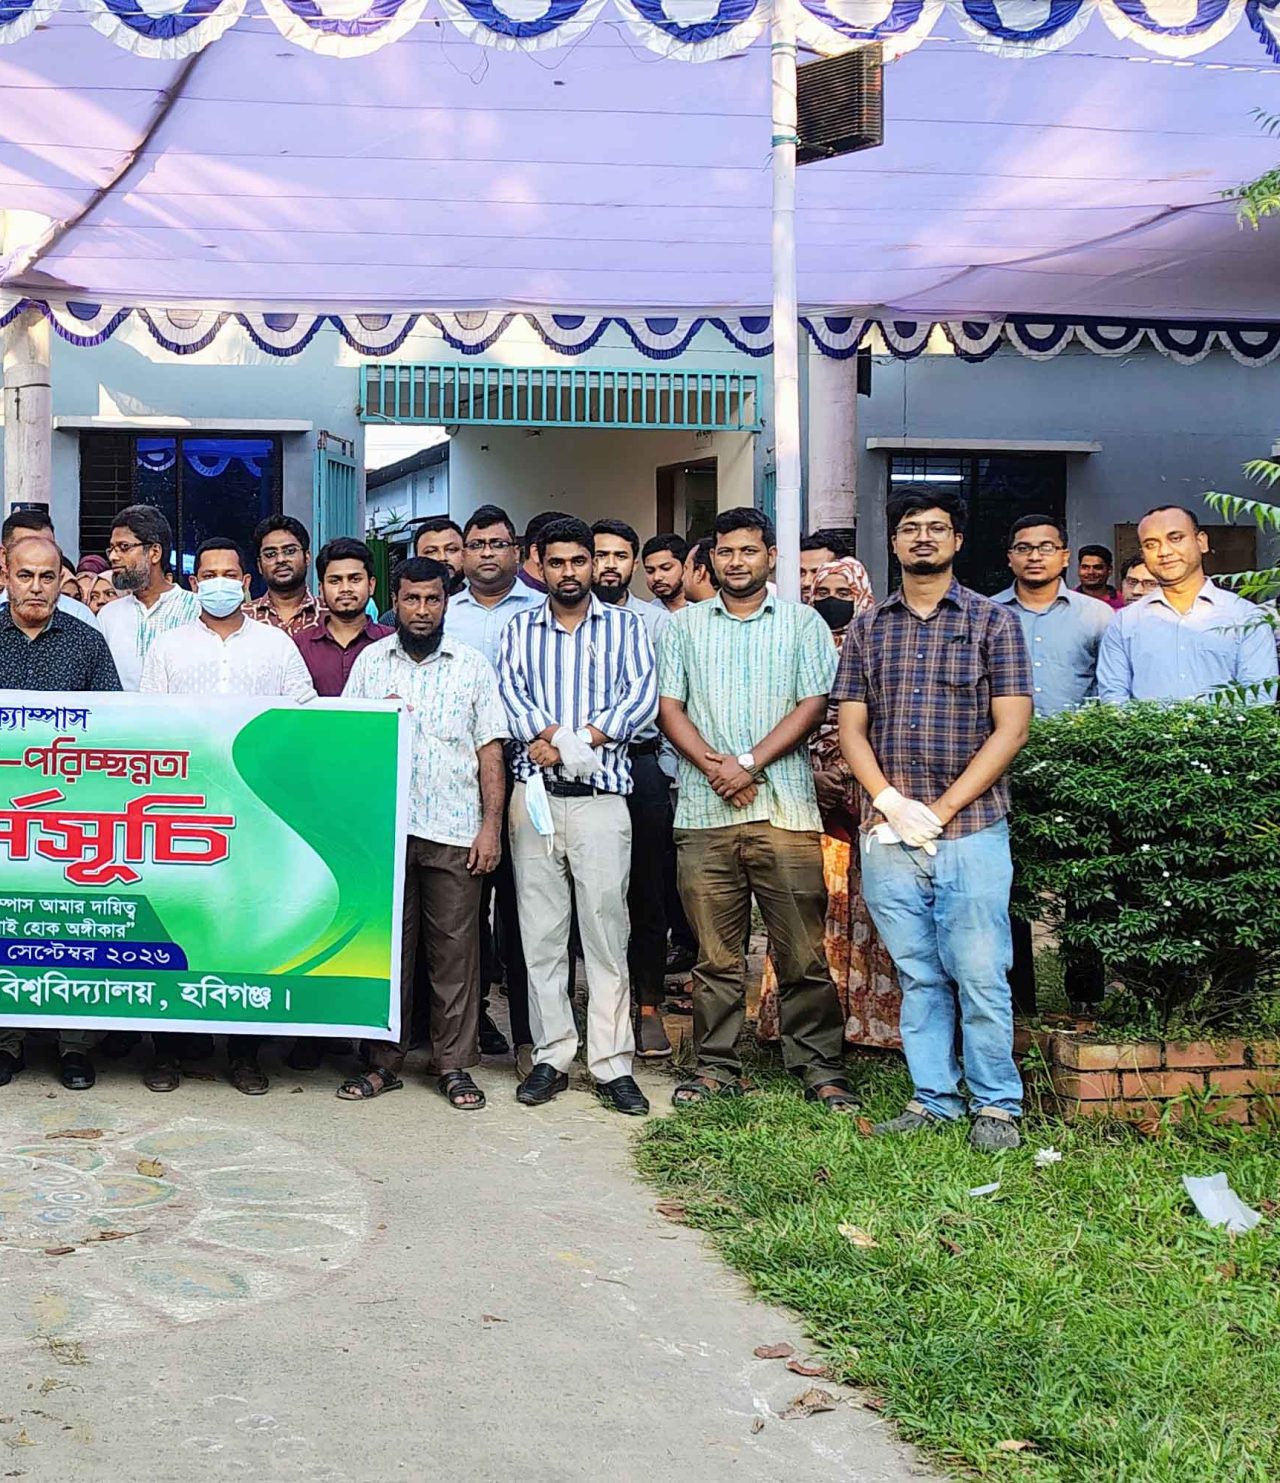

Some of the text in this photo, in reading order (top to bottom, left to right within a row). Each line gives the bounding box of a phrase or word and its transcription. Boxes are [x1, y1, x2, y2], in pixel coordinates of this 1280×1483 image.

[39, 898, 86, 914] আমার
[90, 896, 138, 920] দায়িত্ব
[23, 921, 61, 937] হোক
[7, 941, 98, 962] সেপ্টেম্বর
[106, 947, 171, 965] ২০২৬
[177, 976, 272, 1010] হবিগঞ্জ
